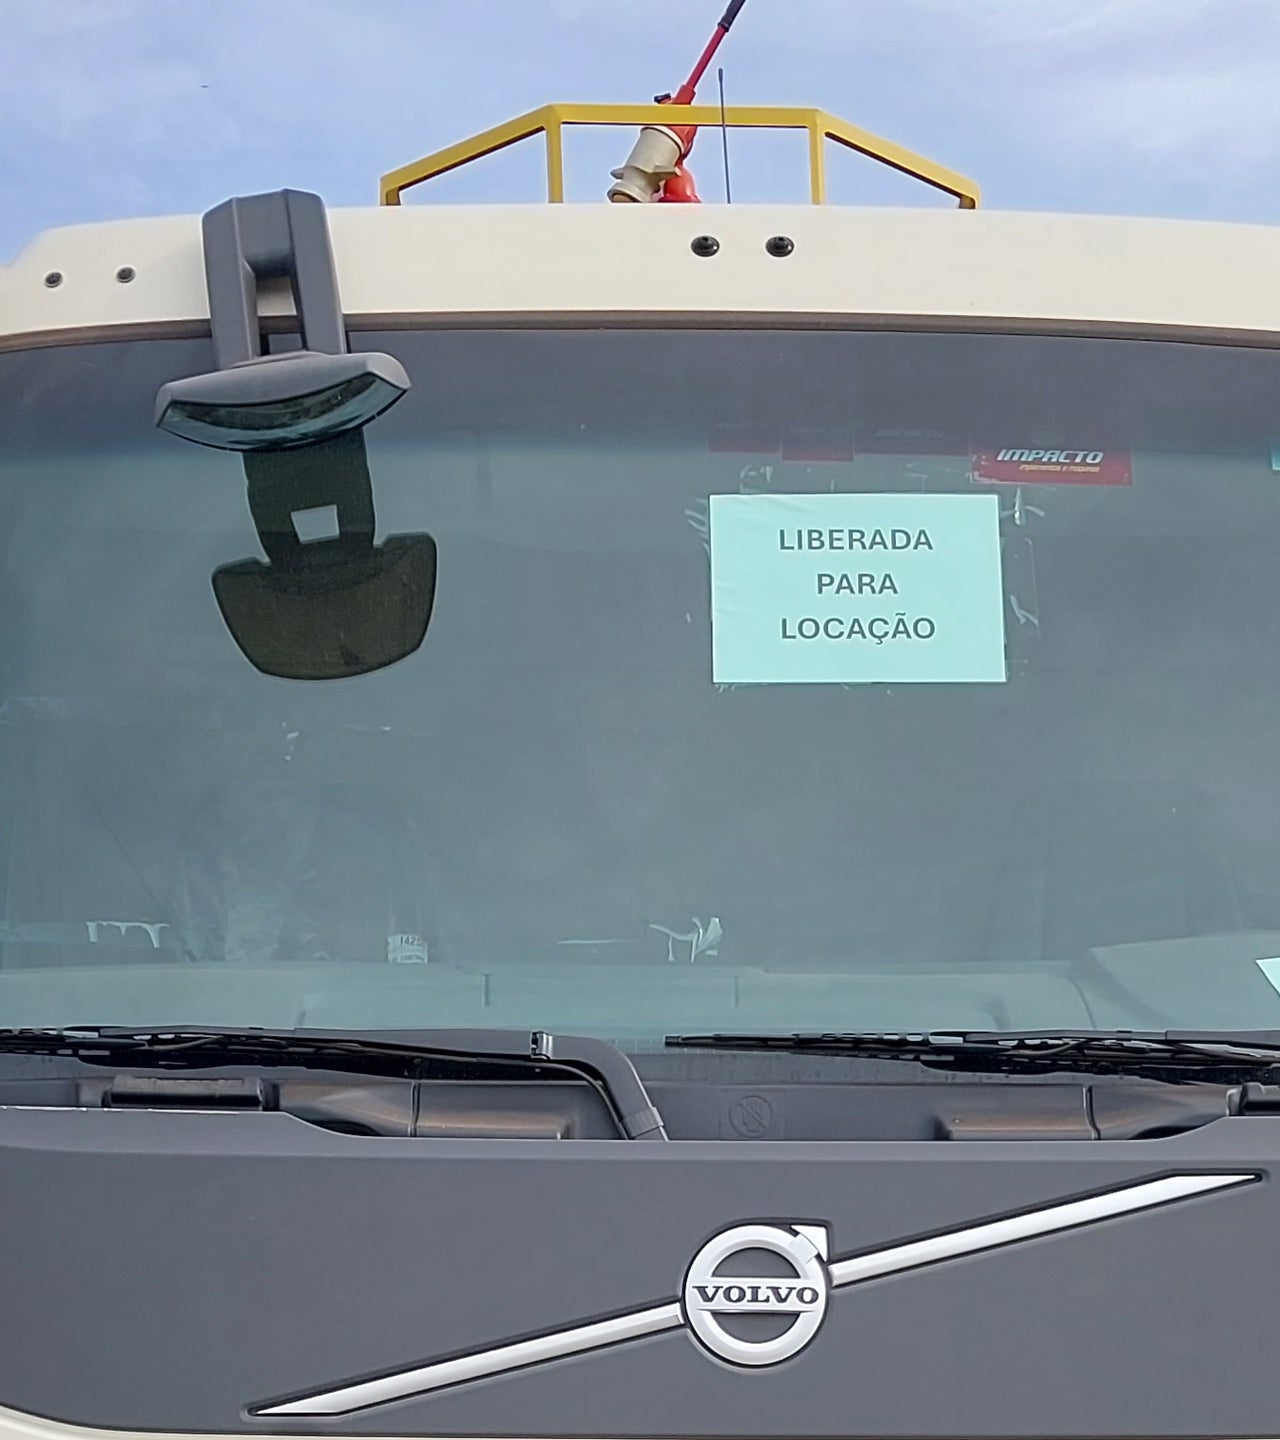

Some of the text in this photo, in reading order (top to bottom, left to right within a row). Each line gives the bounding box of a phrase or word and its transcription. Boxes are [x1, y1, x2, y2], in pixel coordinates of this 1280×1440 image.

[996, 448, 1104, 464] IMPACTO
[778, 528, 934, 551] LIBERADA
[816, 573, 898, 596] PARA
[781, 613, 936, 645] LOCAÇÃO
[692, 1285, 819, 1304] VOLVO
